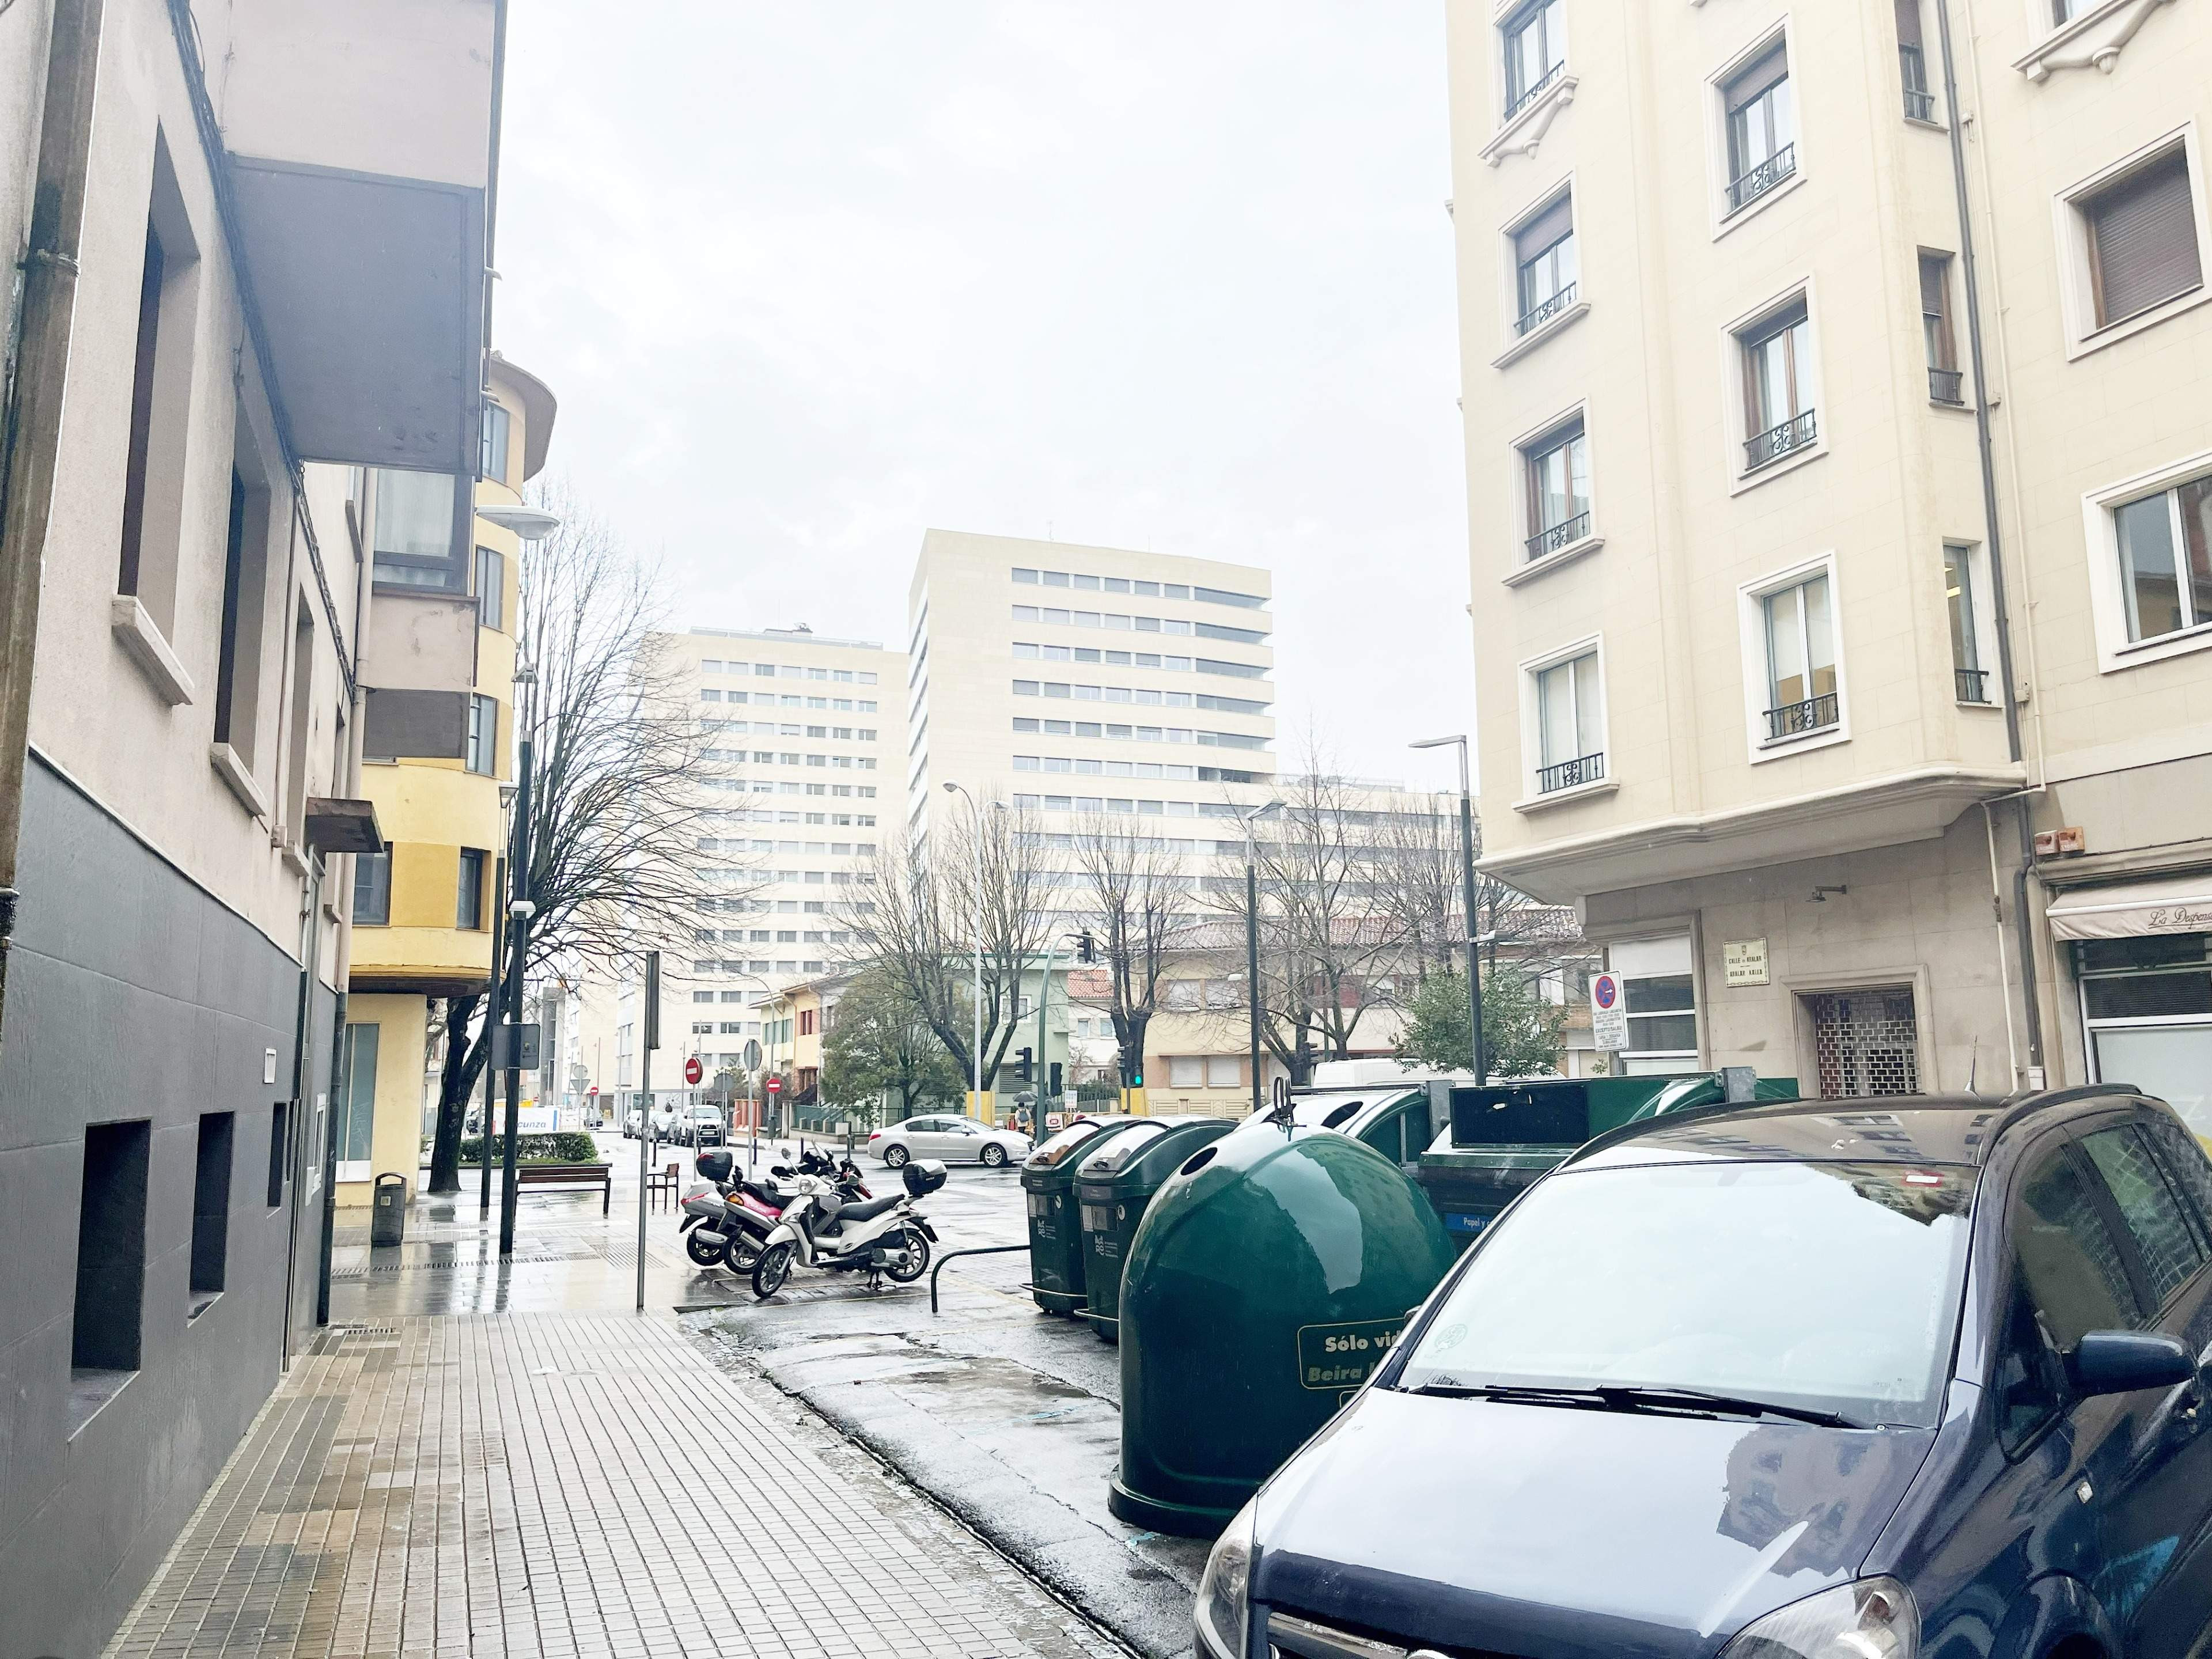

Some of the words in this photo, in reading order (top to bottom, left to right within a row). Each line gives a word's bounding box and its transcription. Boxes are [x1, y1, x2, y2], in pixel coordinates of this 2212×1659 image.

[2148, 909, 2167, 926] La
[1464, 1217, 1480, 1229] Papel
[1325, 1335, 1369, 1353] Sólo
[1374, 1330, 1401, 1348] vid
[1308, 1365, 1362, 1382] Beira
